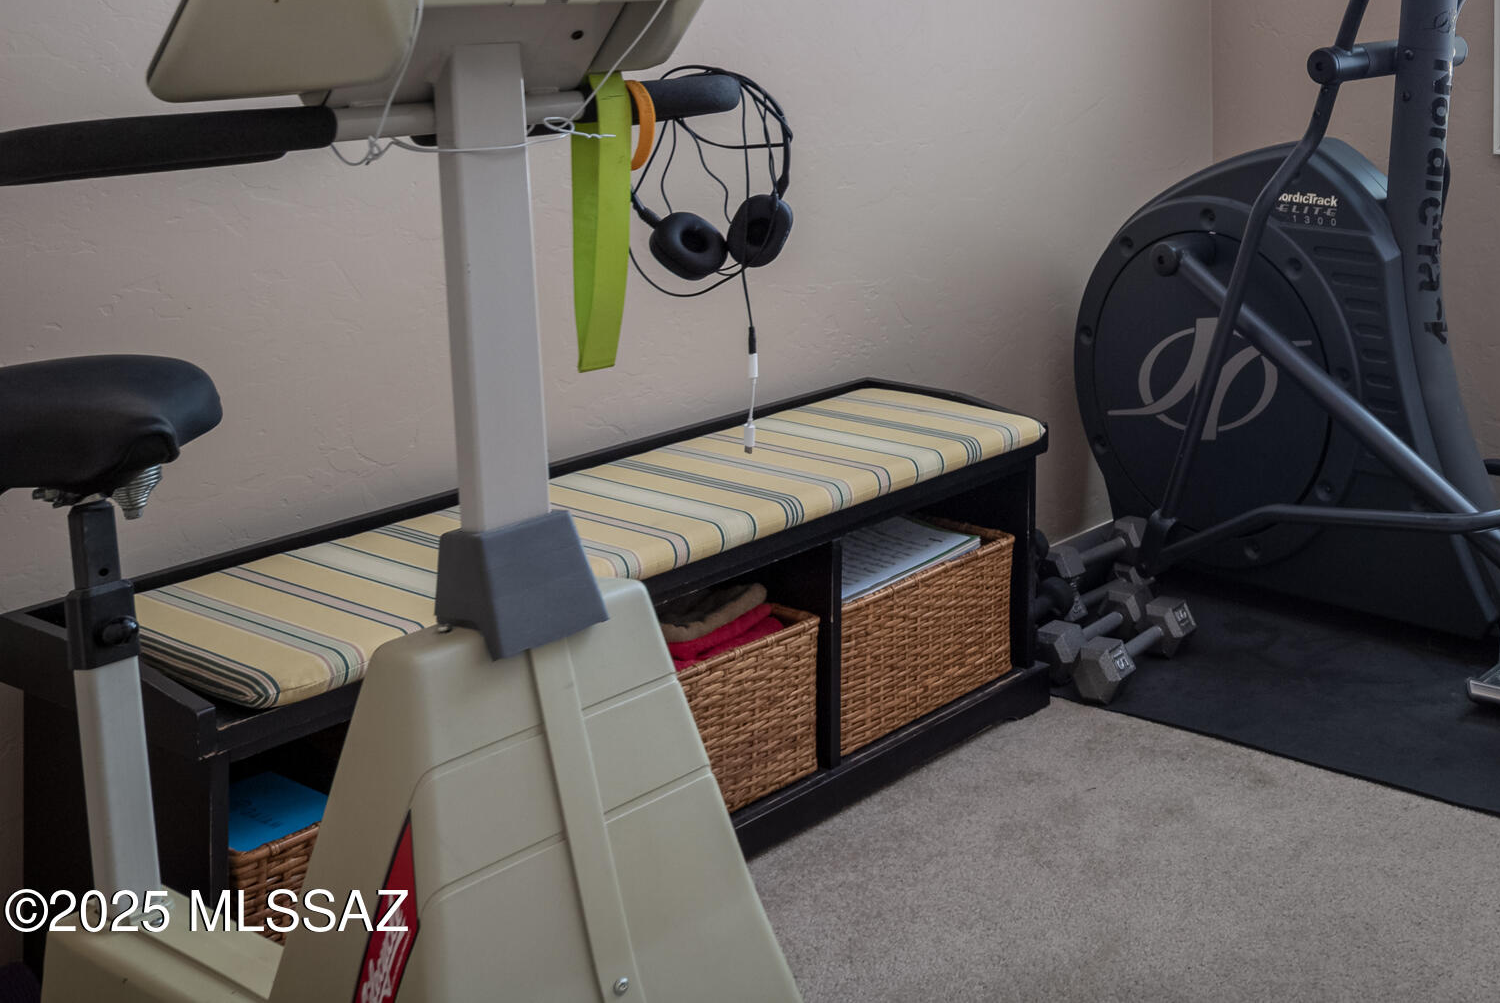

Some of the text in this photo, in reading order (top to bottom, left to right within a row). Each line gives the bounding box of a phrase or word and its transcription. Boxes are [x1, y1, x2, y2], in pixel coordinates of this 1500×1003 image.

[1279, 192, 1338, 207] ordicTrack
[1276, 204, 1337, 217] ELITE
[1113, 649, 1130, 670] 15
